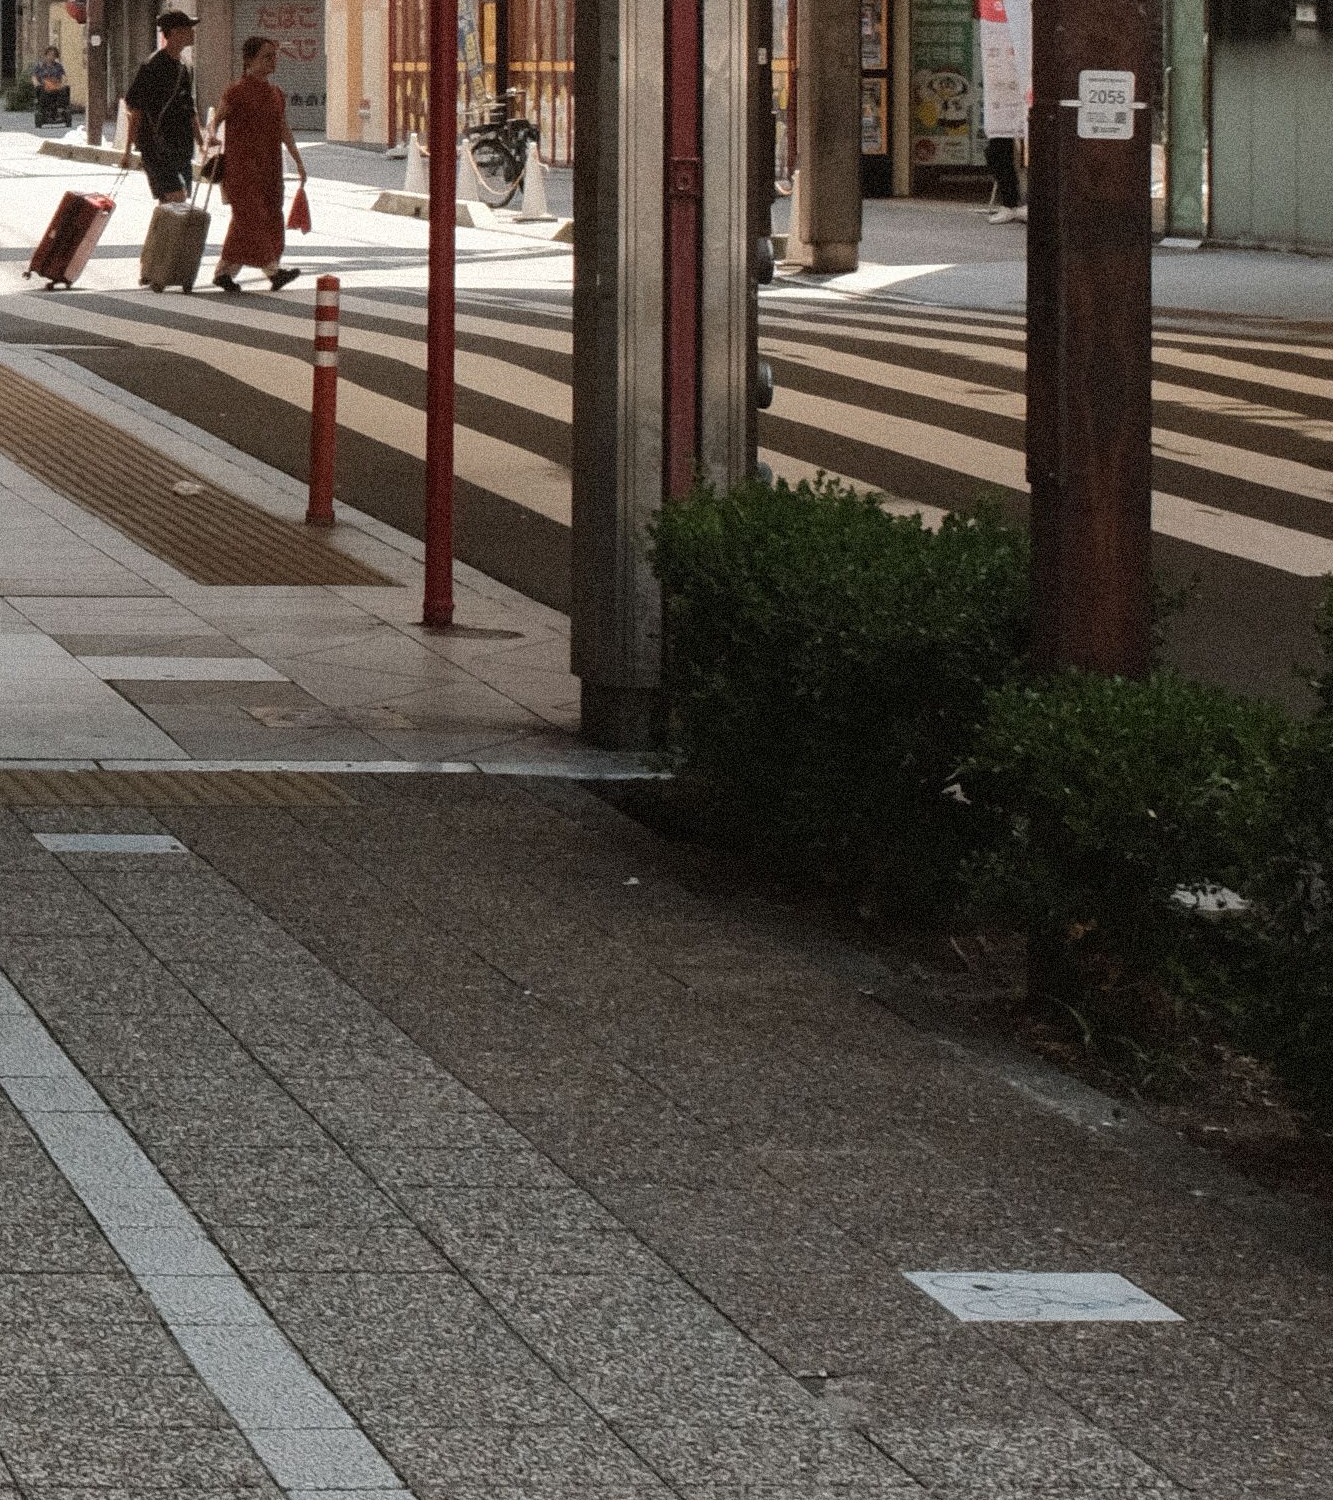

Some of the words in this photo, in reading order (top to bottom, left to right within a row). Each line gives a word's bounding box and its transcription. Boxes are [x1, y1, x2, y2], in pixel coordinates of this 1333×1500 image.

[257, 6, 318, 29] たばこ
[1088, 89, 1126, 105] 2055
